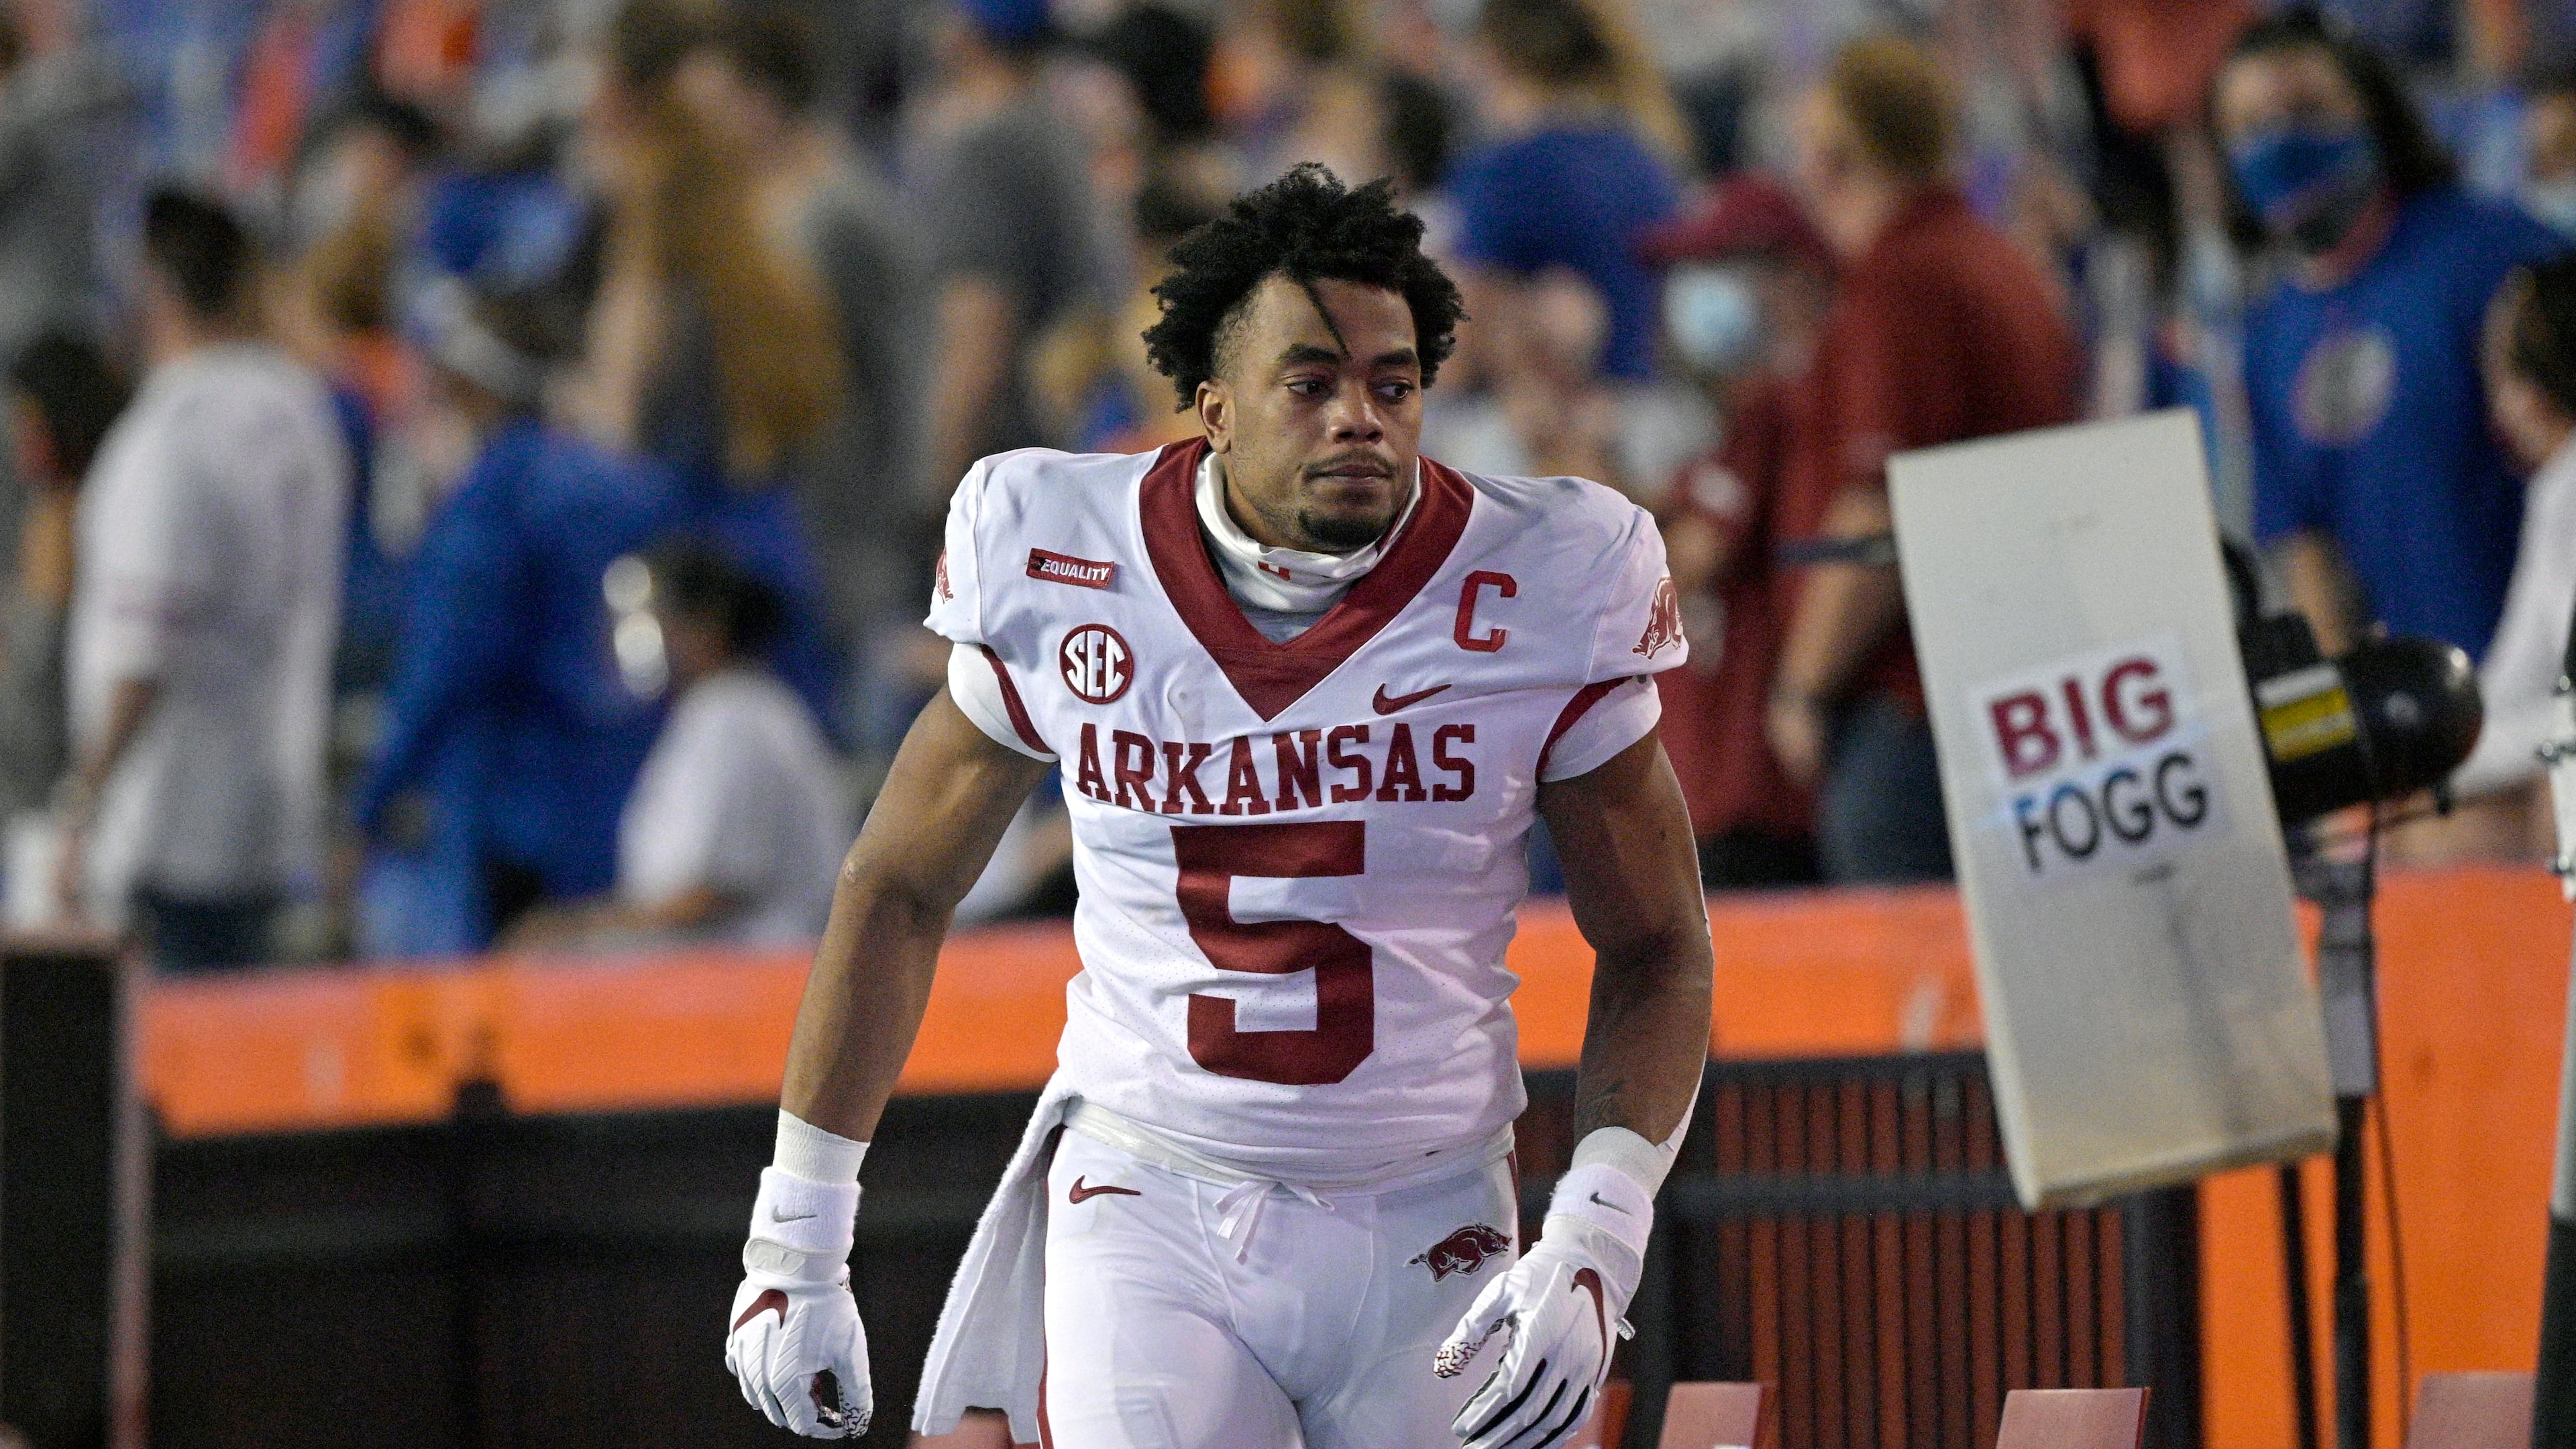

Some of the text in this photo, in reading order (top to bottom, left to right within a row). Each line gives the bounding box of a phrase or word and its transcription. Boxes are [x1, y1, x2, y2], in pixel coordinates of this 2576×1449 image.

[1040, 558, 1110, 581] EQUALITY
[1453, 570, 1517, 653] C
[1065, 631, 1125, 698] SEC
[1989, 656, 2176, 775] BIG
[1076, 722, 1475, 815] ARKANSAS
[2013, 752, 2208, 872] FOGG
[1170, 820, 1374, 1085] 5
